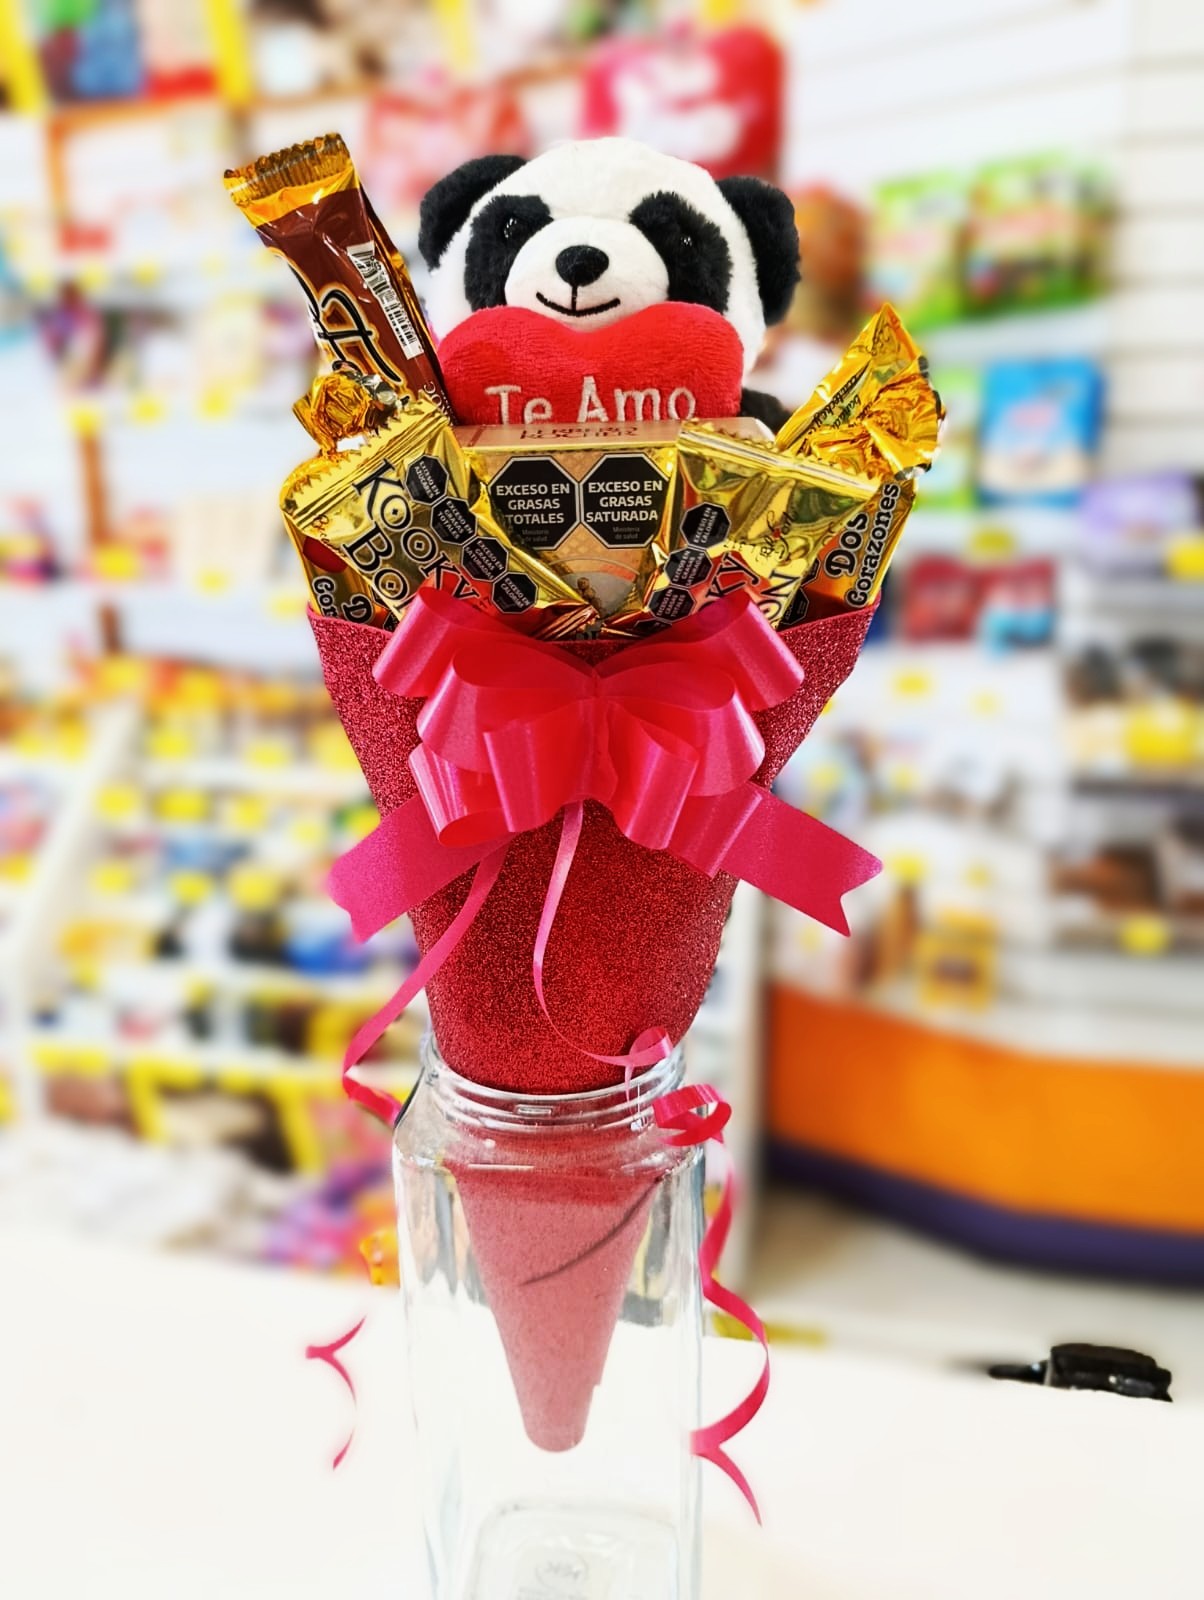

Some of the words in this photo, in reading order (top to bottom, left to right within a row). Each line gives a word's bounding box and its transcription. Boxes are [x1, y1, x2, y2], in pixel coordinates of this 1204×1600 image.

[485, 385, 553, 425] Te
[575, 374, 698, 424] Amo
[496, 483, 548, 496] EXCESO
[552, 482, 570, 495] EN
[588, 481, 640, 494] EXCESO
[644, 480, 663, 492] EN
[508, 498, 561, 511] GRASAS
[599, 495, 653, 508] GRASAS
[443, 509, 465, 534] GRASAS
[505, 512, 565, 525] TOTALES
[586, 509, 658, 523] SATURADA
[437, 511, 460, 540] TOTALES
[823, 511, 869, 579] Dos
[845, 482, 901, 608] Corazones
